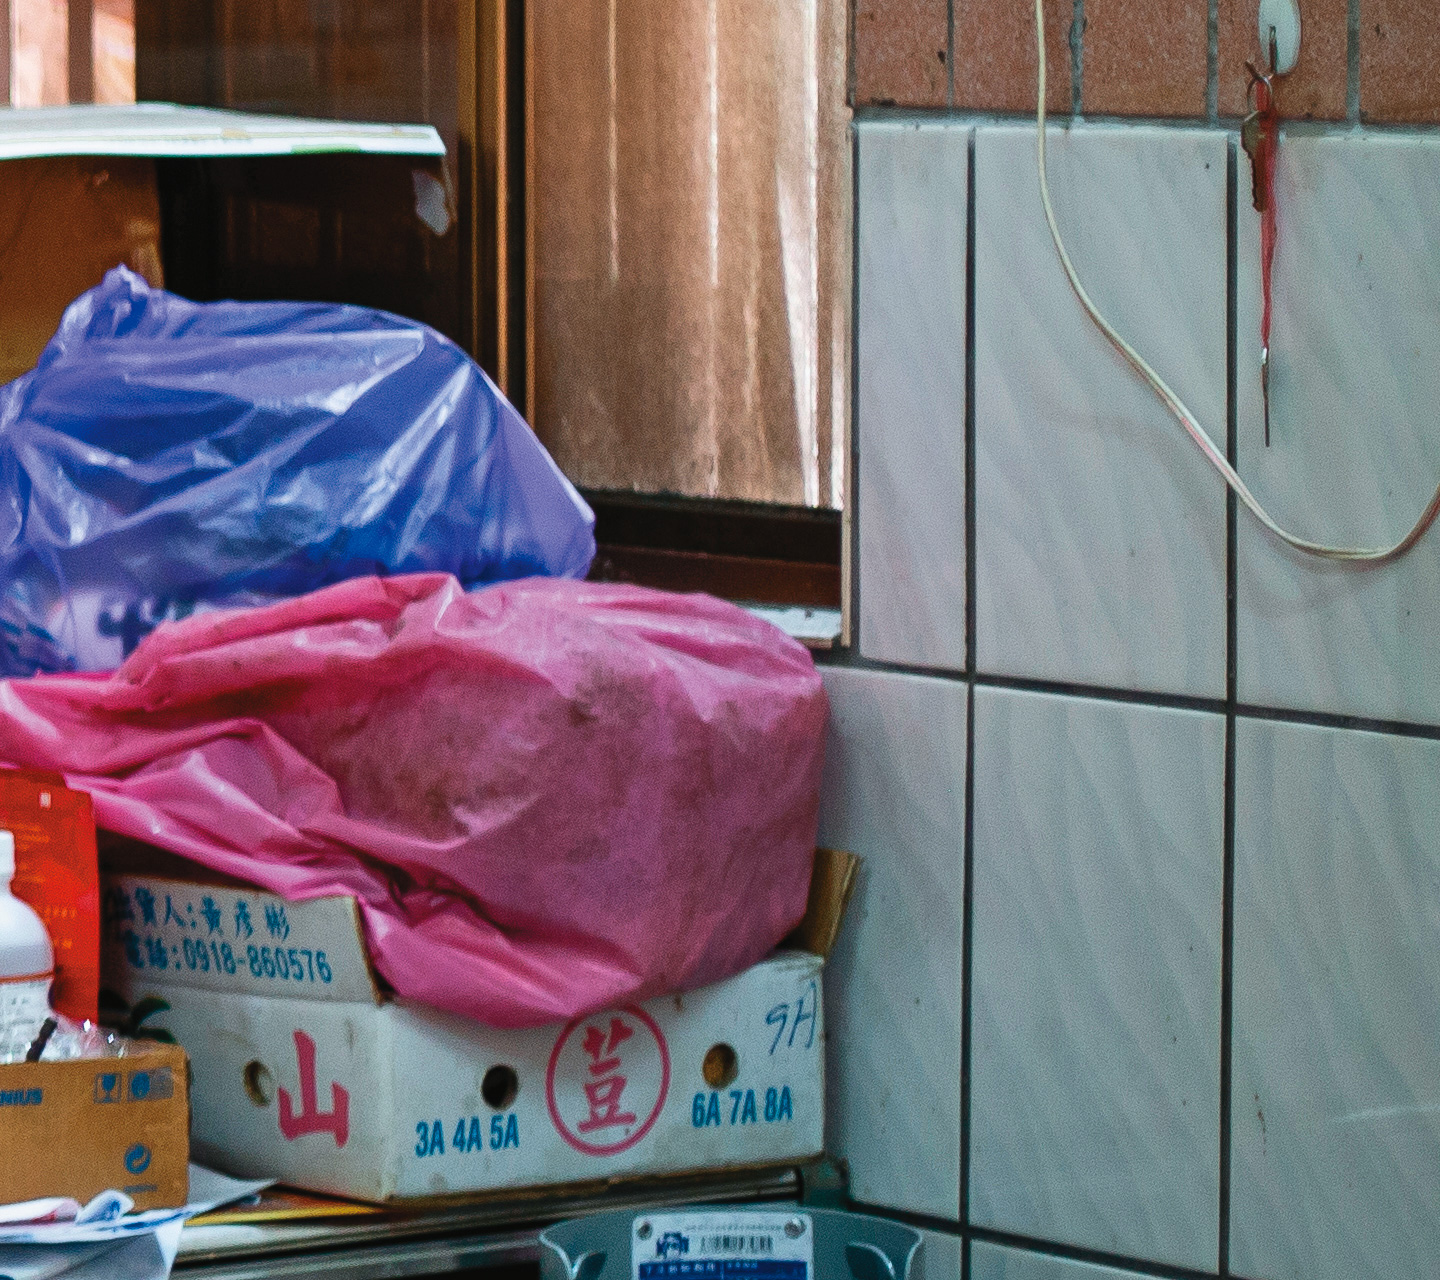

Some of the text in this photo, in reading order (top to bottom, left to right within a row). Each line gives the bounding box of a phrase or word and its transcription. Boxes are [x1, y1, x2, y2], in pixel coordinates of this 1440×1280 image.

[277, 1028, 351, 1150] 山
[691, 1085, 793, 1129] 6A 7A 8A
[414, 1113, 520, 1158] 3A 4A 5A
